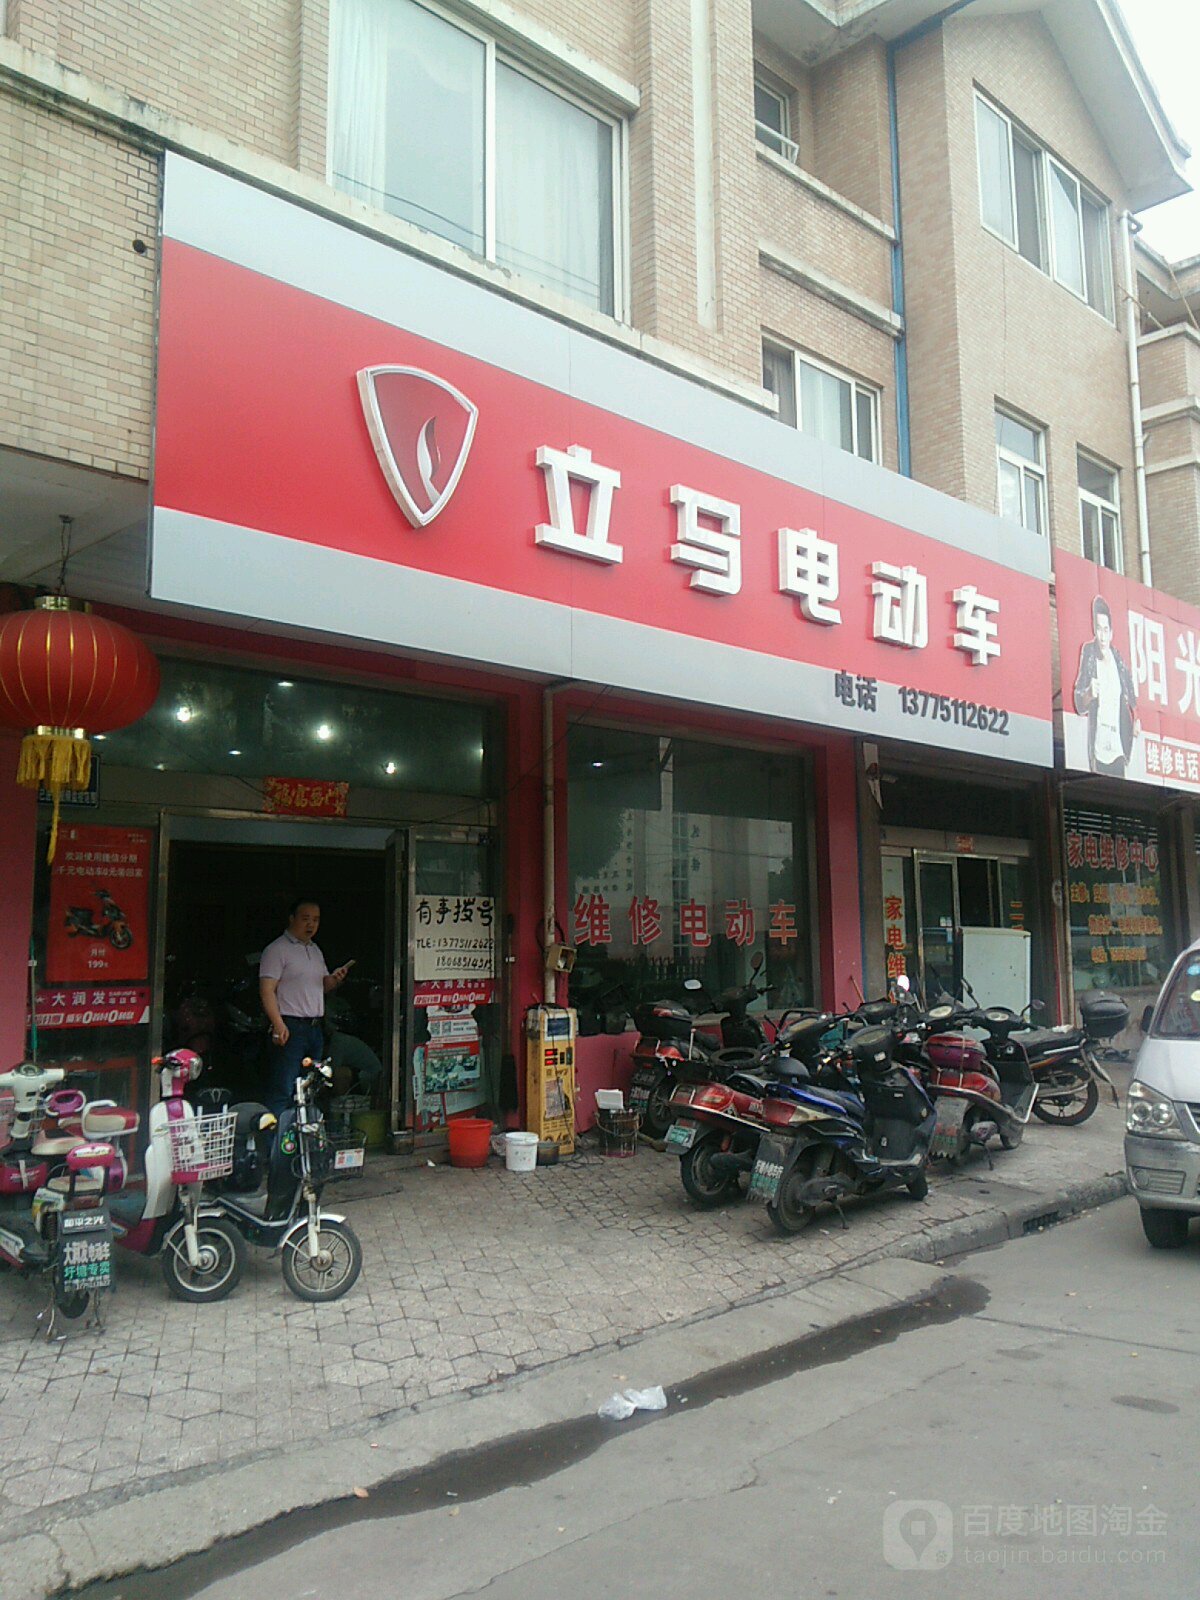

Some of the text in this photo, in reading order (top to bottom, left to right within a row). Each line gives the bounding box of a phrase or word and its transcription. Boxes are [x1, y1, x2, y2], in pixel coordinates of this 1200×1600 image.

[534, 444, 1002, 667] 立马电动车
[835, 669, 1010, 737] 电话 13775112622
[1147, 742, 1199, 781] 维修电话
[1067, 832, 1159, 873] 家电维修中心
[416, 897, 494, 927] 有事拨号
[573, 892, 798, 947] 维修电动车
[885, 895, 908, 1004] 家电维
[51, 991, 106, 1007] 大润发
